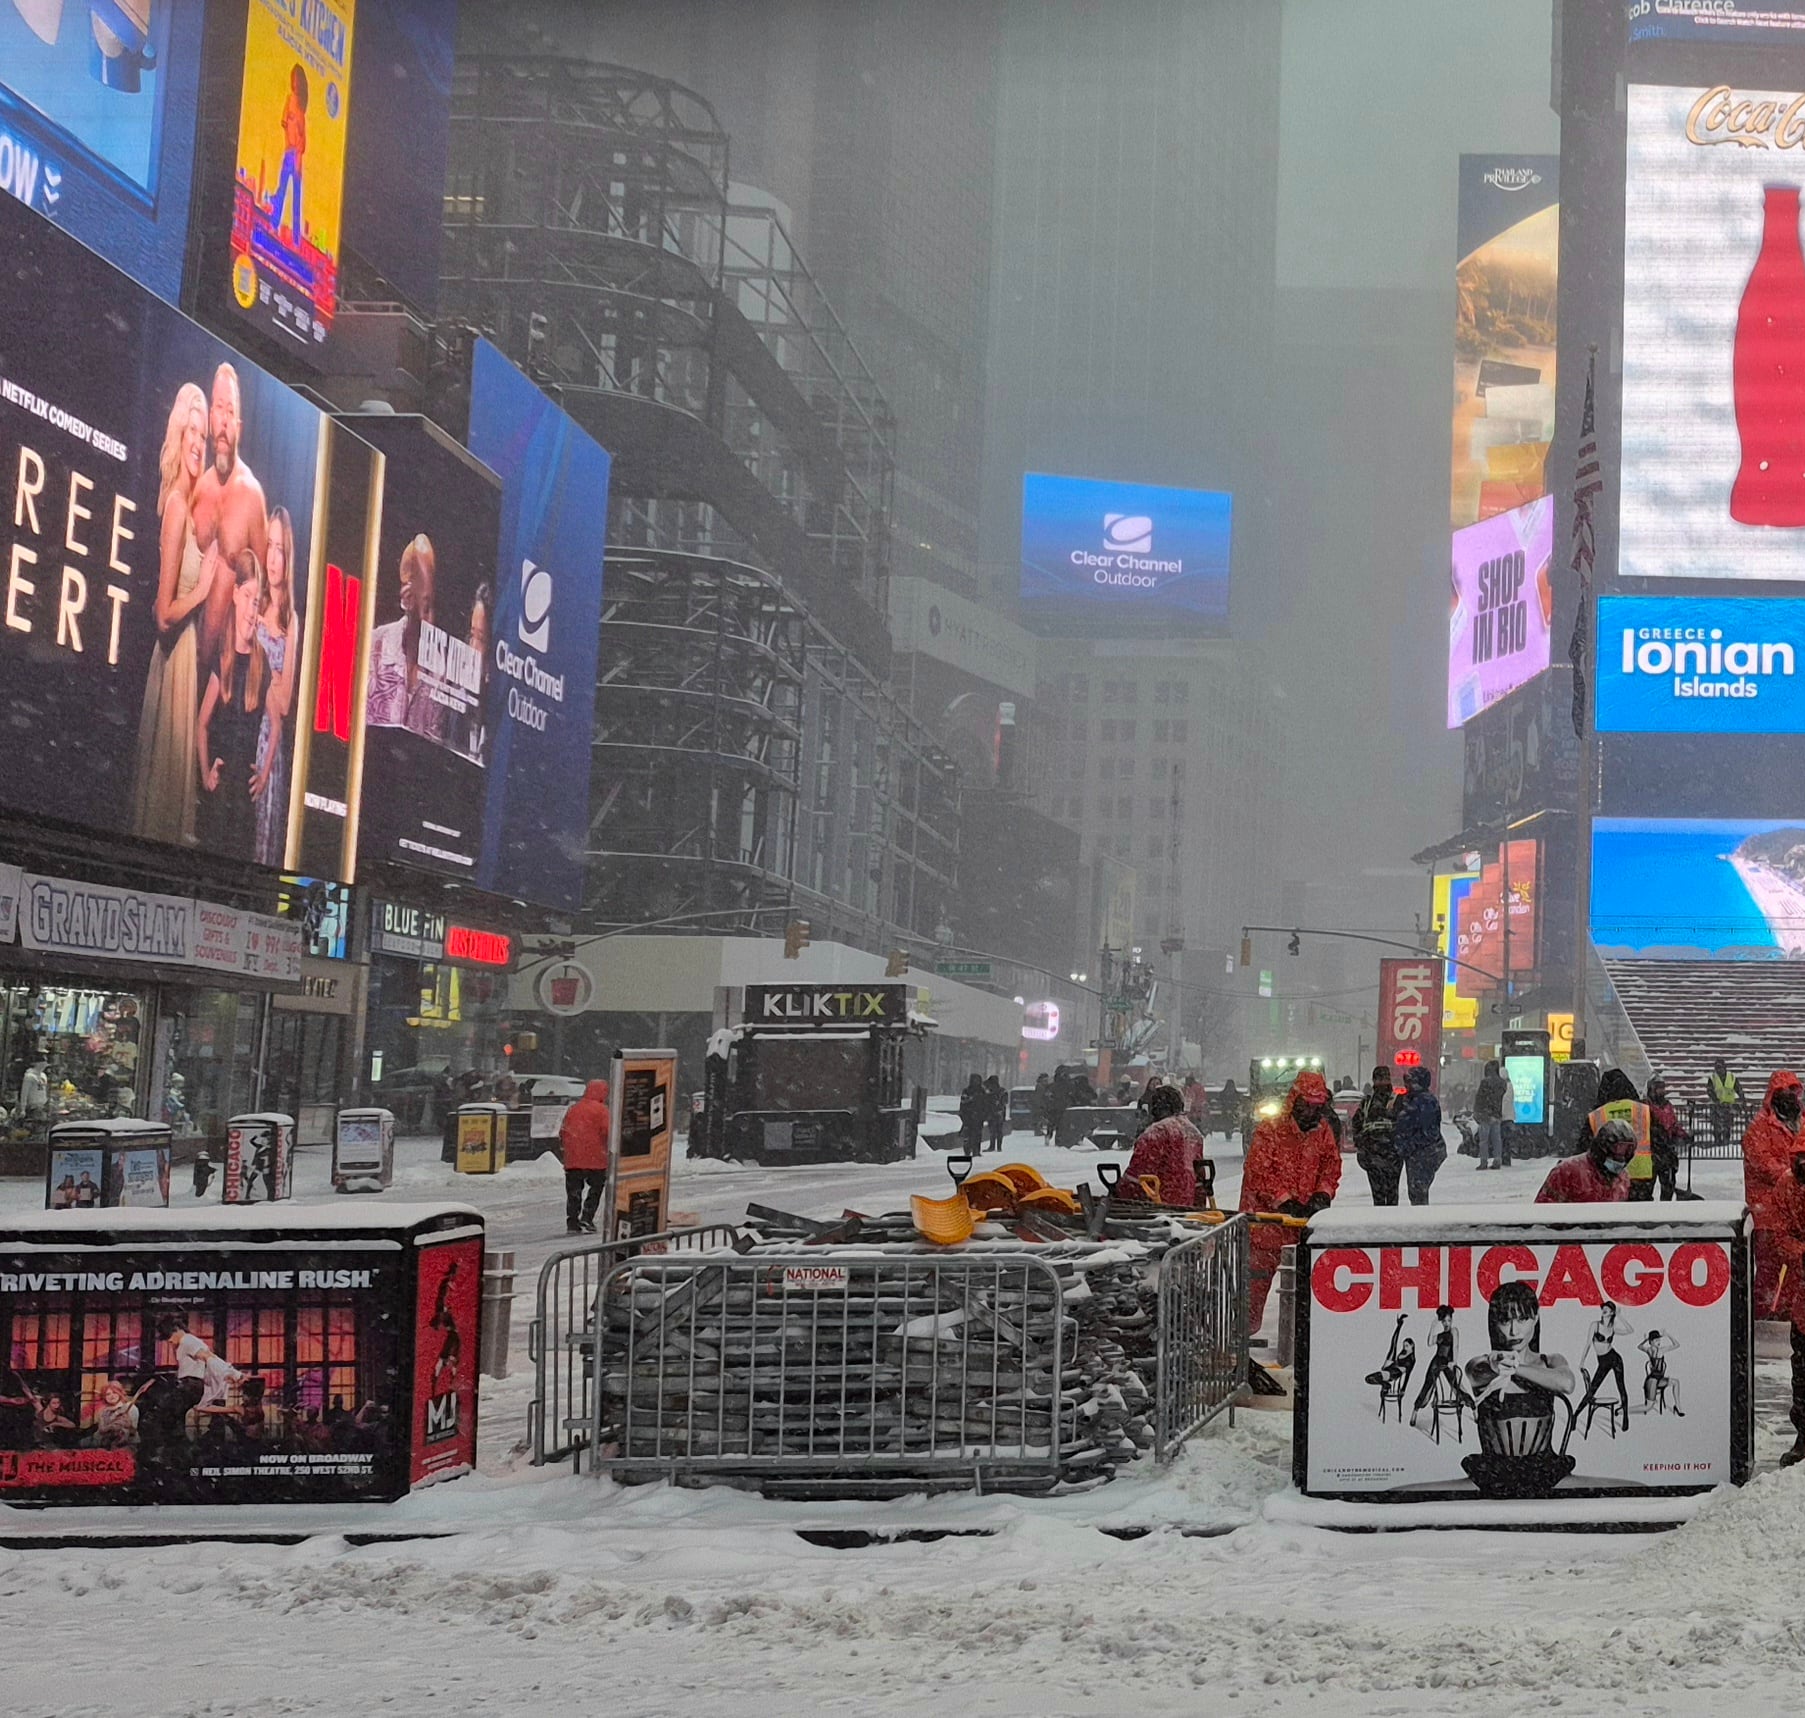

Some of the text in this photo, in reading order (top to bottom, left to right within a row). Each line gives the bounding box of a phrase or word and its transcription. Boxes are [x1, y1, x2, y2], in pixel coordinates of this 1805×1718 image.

[2, 378, 128, 463] NETFLIX COMEDY SERIES
[1070, 550, 1182, 573] Clear Channel
[1094, 569, 1158, 588] Outdoor
[1477, 549, 1525, 613] SHOP
[1472, 600, 1527, 665] IN BIO
[1639, 628, 1706, 640] GREECE
[1622, 628, 1795, 675] Ionian
[495, 639, 524, 680] Clear
[524, 655, 564, 702] Channel
[1674, 676, 1758, 698] Islands
[508, 687, 548, 732] Outdoor
[385, 904, 445, 941] BLUE FIN
[763, 992, 886, 1017] KLIKTIX
[1393, 964, 1432, 1041] tkts
[227, 1128, 242, 1202] CHICAGO
[0, 1272, 124, 1292] RIVETING
[128, 1270, 294, 1291] ADRENALINE
[787, 1268, 845, 1280] NATIONAL
[1311, 1242, 1731, 1312] CHICAGO
[428, 1391, 457, 1434] MJ
[27, 1461, 124, 1473] THE MUSICAL
[223, 1466, 251, 1476] SIMON
[312, 1465, 337, 1475] WEST
[260, 1453, 374, 1464] NOW ON BROADWAY
[1643, 1462, 1712, 1472] KEEPING IT HOT
